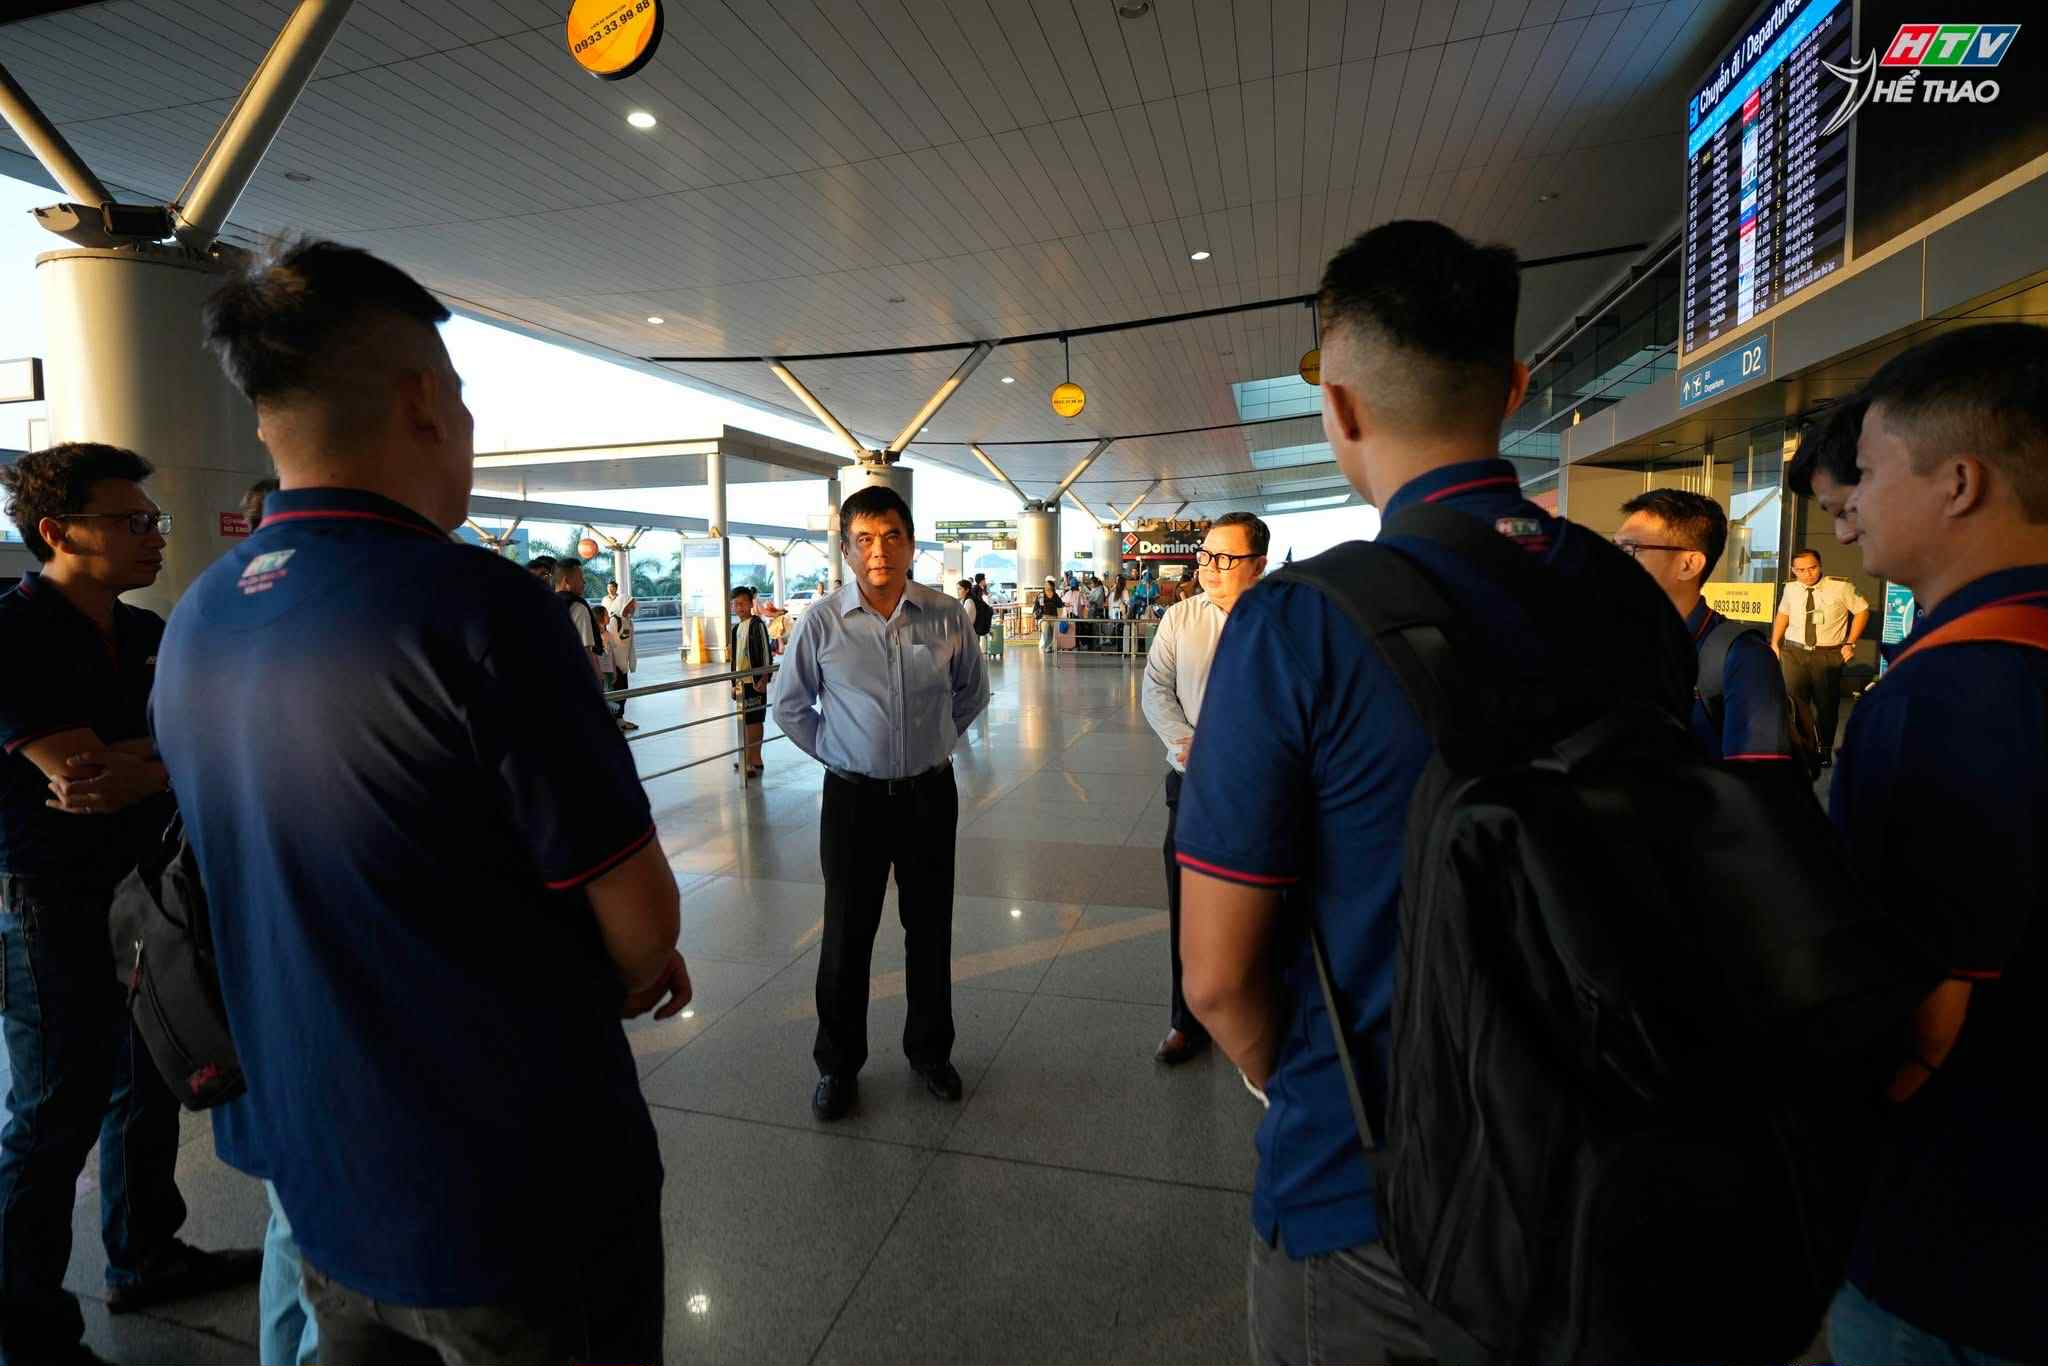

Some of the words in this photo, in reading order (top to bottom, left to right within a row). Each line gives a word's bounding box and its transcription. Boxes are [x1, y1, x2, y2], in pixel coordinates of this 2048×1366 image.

[1743, 345, 1761, 376] D2
[1140, 540, 1202, 554] Domino'
[1731, 600, 1740, 613] 33
[1741, 601, 1750, 614] 99
[1752, 601, 1761, 615] 88
